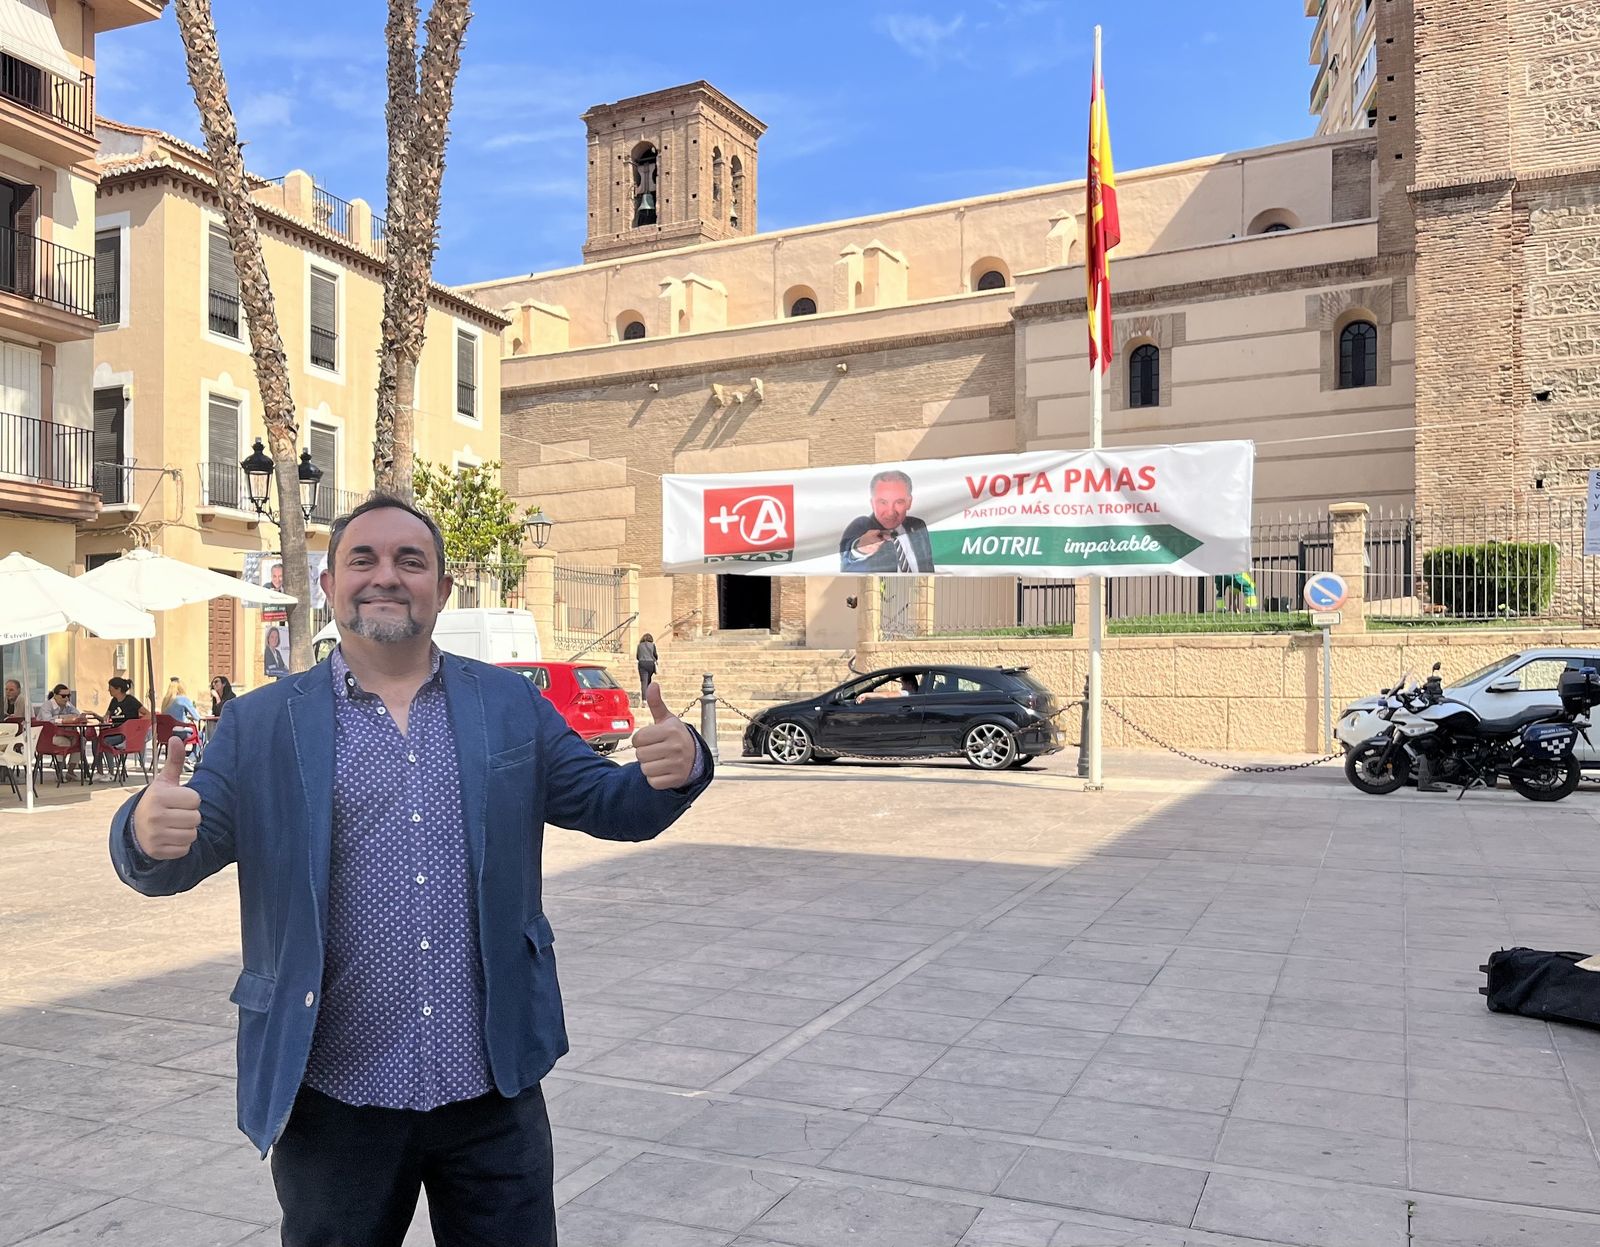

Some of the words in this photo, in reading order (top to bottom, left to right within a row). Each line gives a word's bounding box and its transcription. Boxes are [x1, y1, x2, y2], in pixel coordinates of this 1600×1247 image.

[965, 472, 1053, 499] VOTA
[1064, 465, 1156, 493] PMAS
[963, 506, 1016, 519] PARTIDO
[1021, 501, 1050, 515] MÁS
[1054, 503, 1094, 516] COSTA
[1098, 502, 1160, 515] TROPICAL
[961, 536, 1043, 557] MOTRIL
[1064, 534, 1162, 559] imparable
